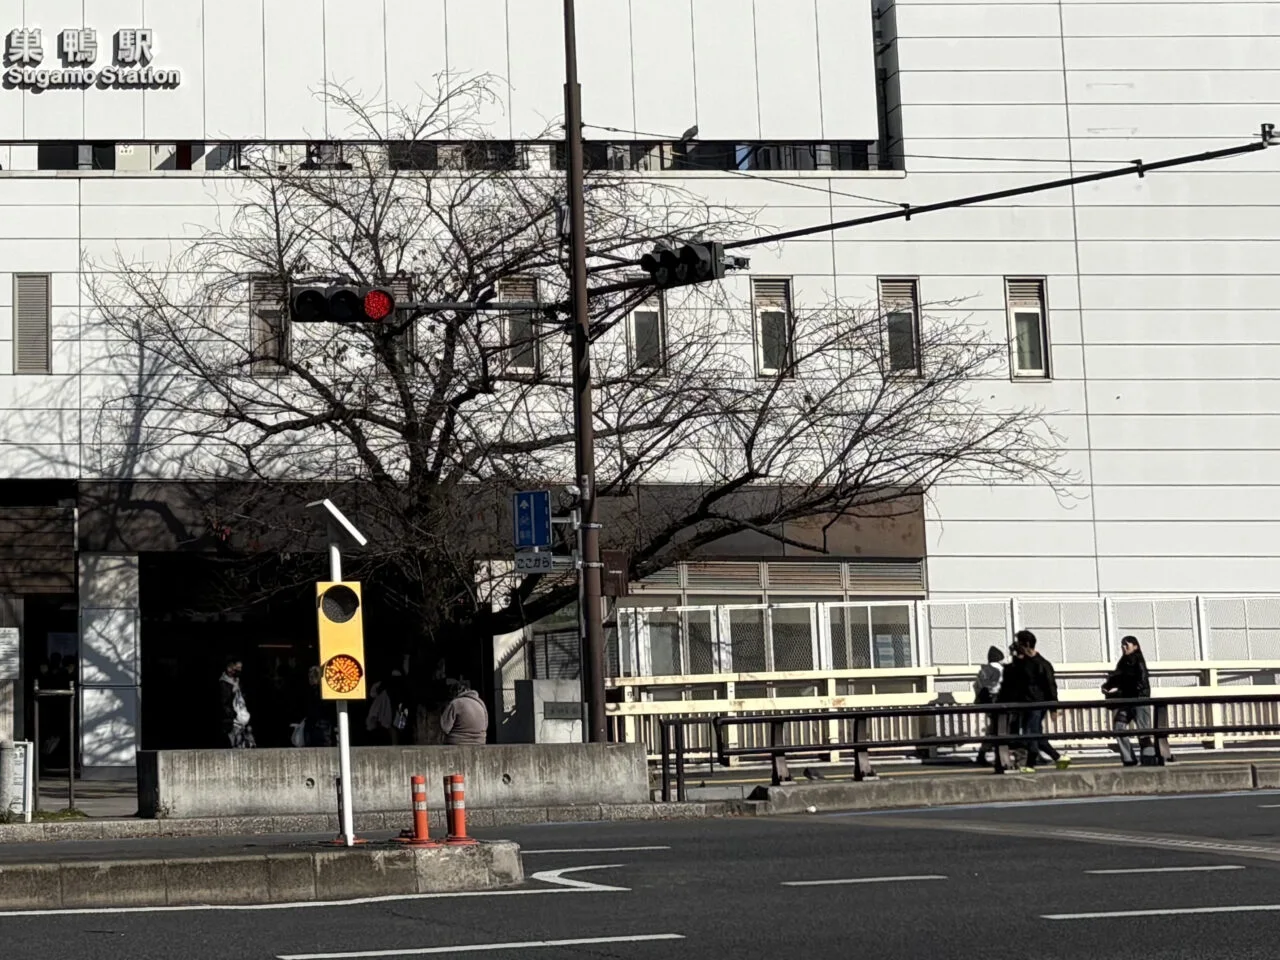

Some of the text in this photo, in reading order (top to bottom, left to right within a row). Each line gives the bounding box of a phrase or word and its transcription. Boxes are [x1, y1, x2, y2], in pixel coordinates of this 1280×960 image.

[7, 27, 153, 63] 巣鴨駅
[7, 65, 181, 88] Sugamo Station
[517, 557, 550, 569] ここから
